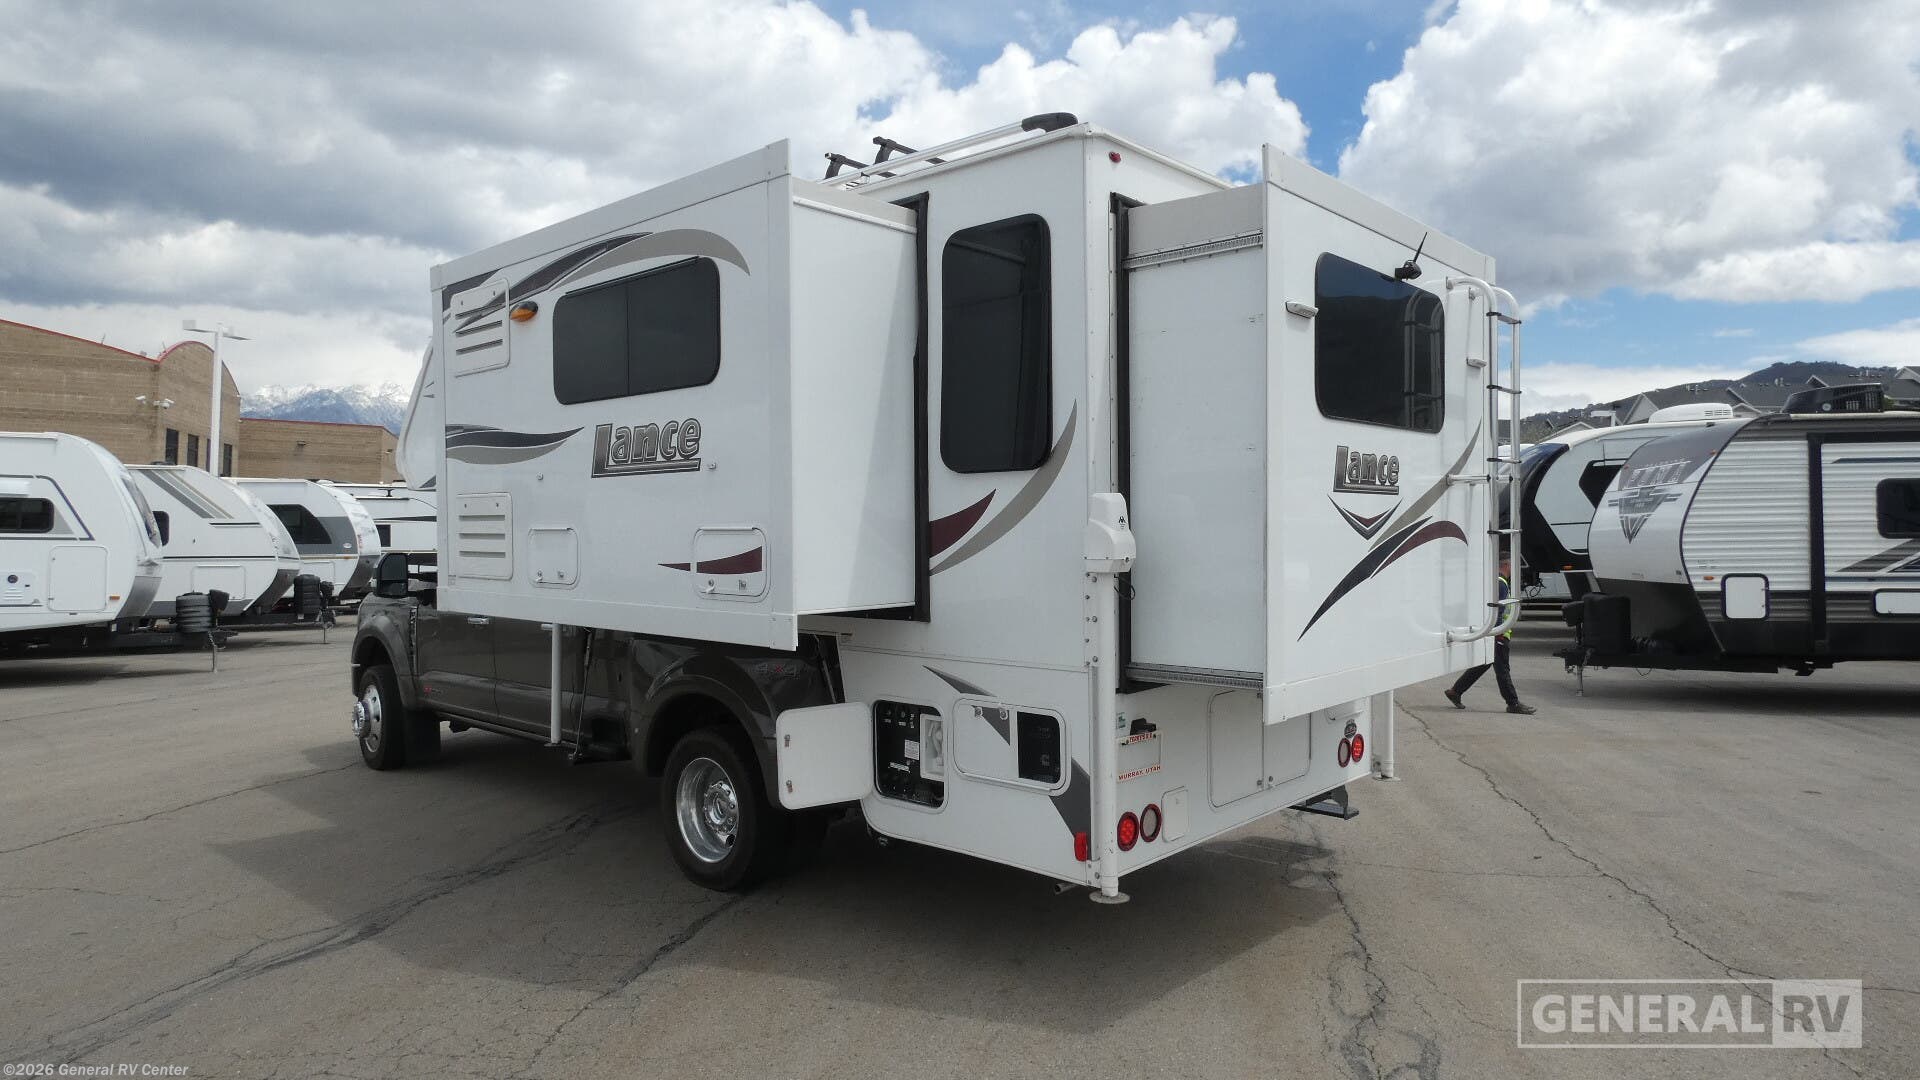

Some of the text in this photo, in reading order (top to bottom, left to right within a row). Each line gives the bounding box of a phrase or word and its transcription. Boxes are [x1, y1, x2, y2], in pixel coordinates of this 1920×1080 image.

[591, 418, 702, 478] Lance
[1333, 445, 1400, 495] Lance
[1145, 765, 1161, 774] UTAH
